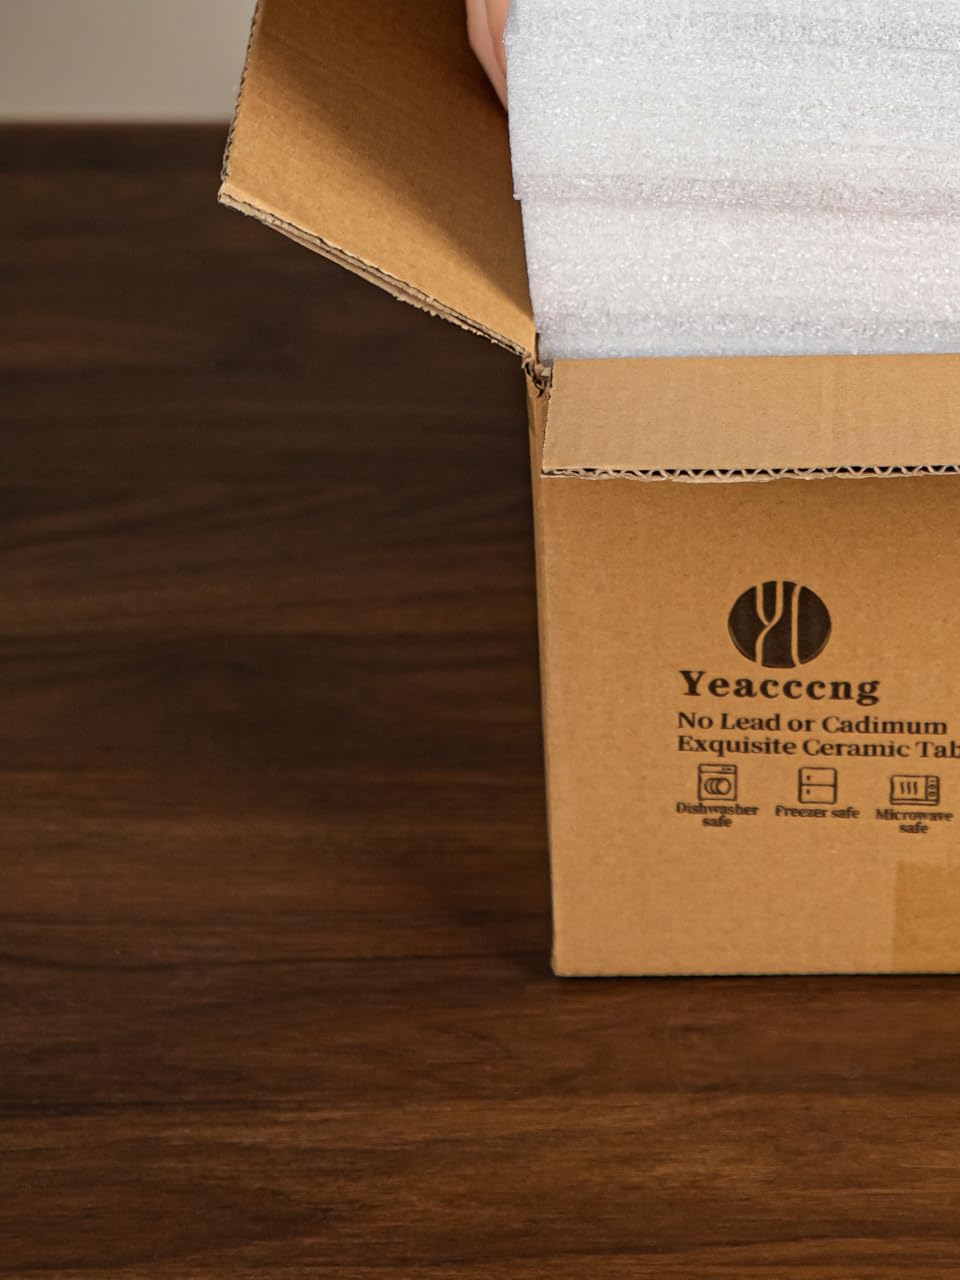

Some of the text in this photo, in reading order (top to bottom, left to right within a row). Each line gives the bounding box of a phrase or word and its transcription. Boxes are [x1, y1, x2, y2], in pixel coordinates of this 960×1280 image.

[679, 670, 880, 707] Yeacccng
[677, 711, 948, 736] No Lead or Cadimum
[677, 735, 797, 758] Exquisite
[802, 739, 910, 757] Ceramic
[675, 802, 760, 816] Dishwasher
[775, 805, 861, 819] Freezer safe
[875, 808, 954, 822] Microwave
[702, 815, 733, 828] safe
[899, 821, 929, 834] safe
